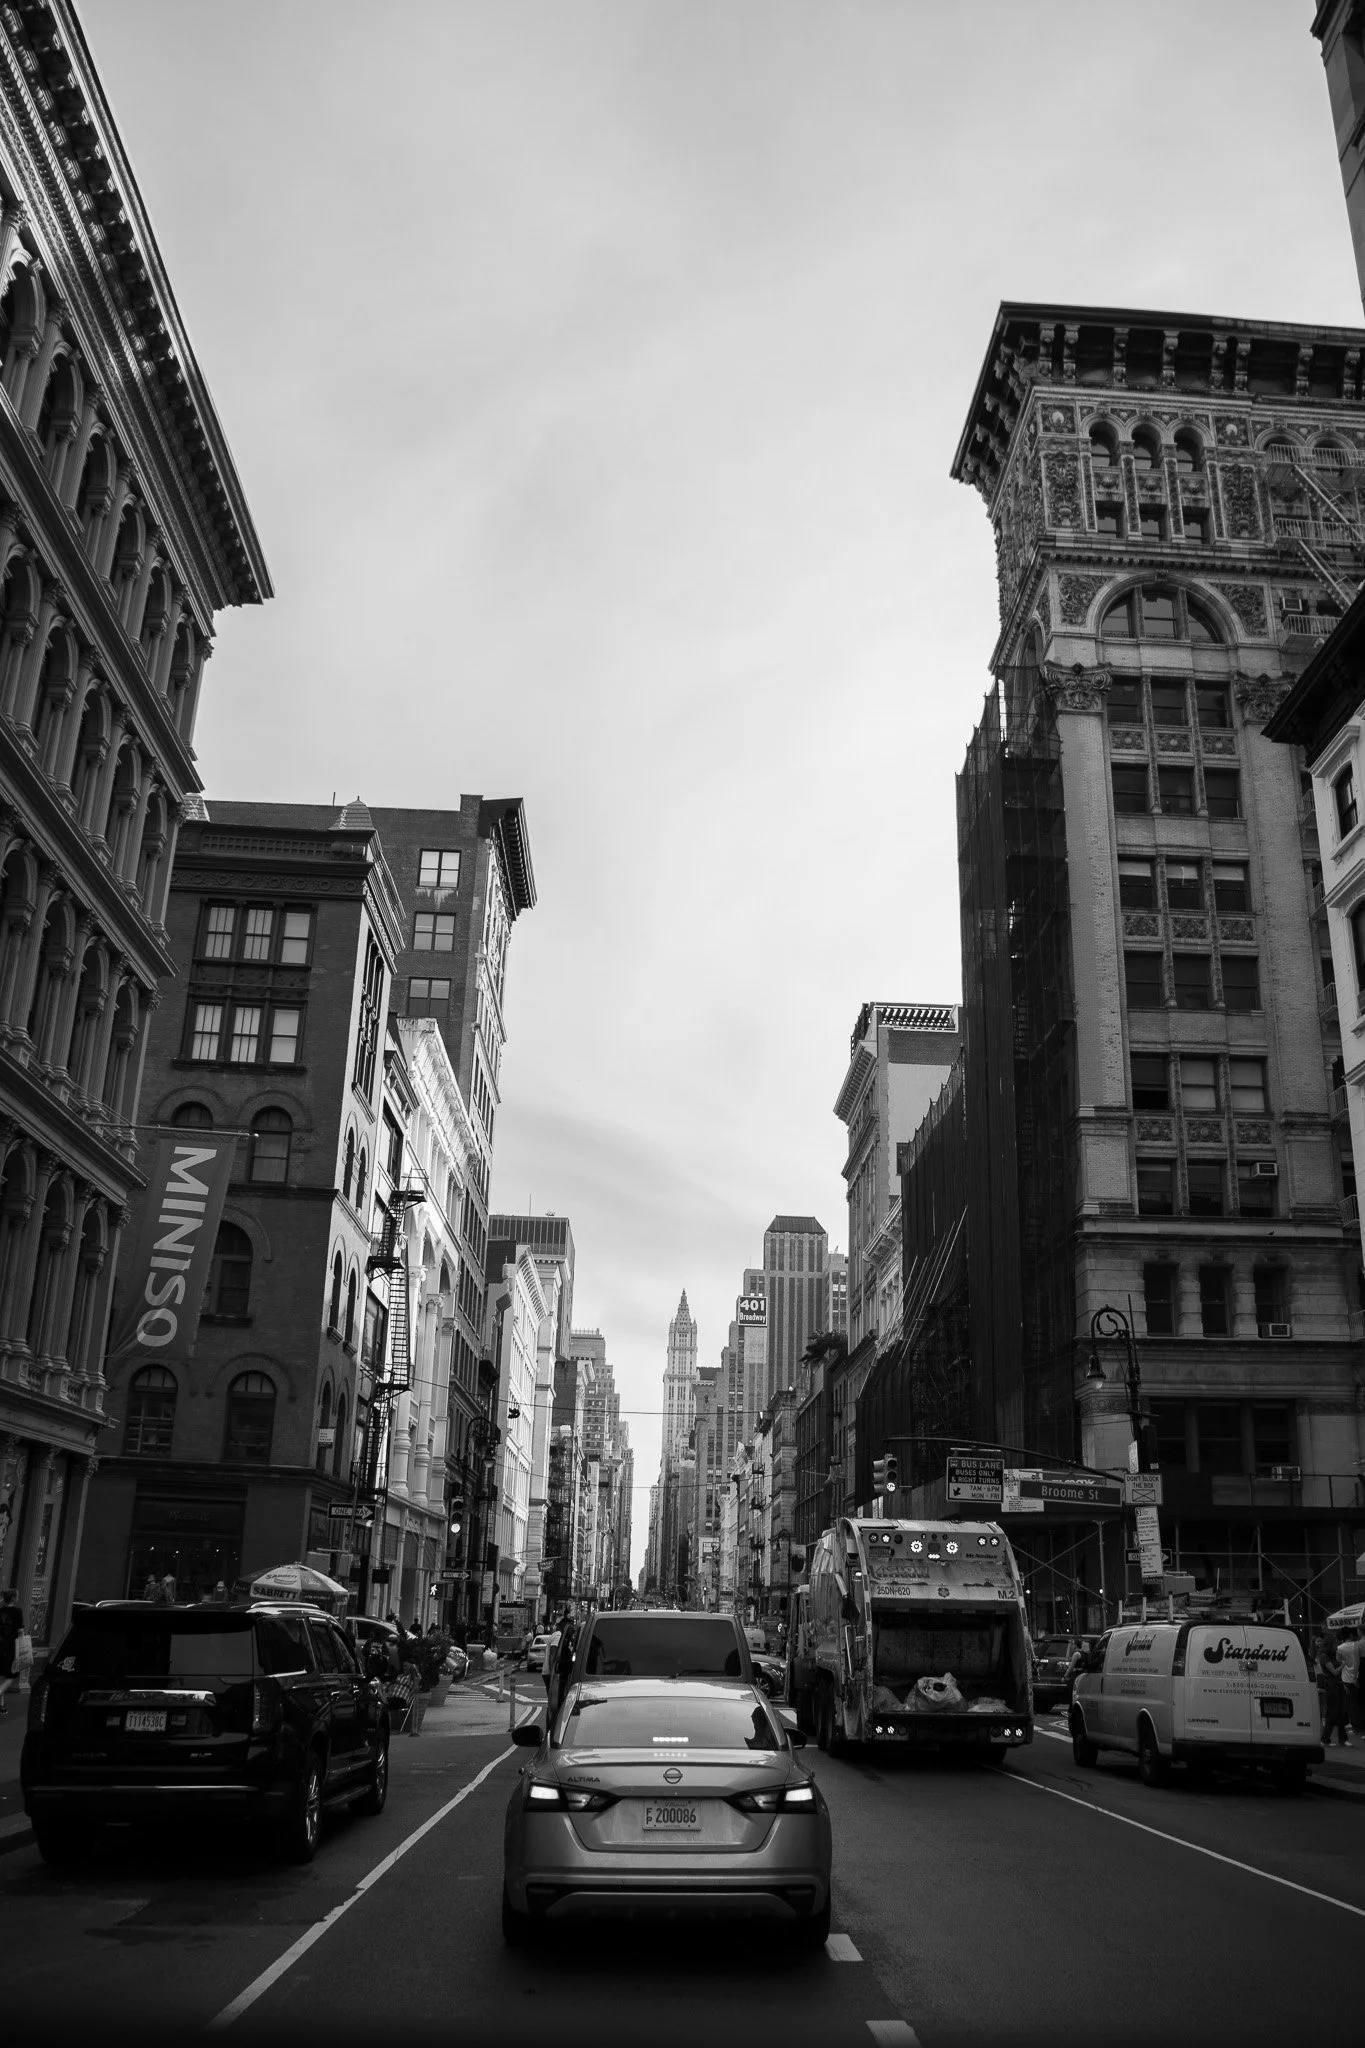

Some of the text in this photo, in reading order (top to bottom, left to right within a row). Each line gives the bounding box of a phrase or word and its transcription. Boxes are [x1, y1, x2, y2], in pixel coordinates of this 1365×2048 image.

[137, 1146, 217, 1347] MINISO
[740, 1300, 765, 1311] 401
[961, 1460, 1001, 1469] BUS LANE
[957, 1475, 976, 1483] RIGHT
[978, 1476, 1000, 1484] TURNS
[1041, 1485, 1099, 1500] Broome St
[335, 1507, 349, 1515] ONE
[253, 1586, 298, 1599] SABRETT
[877, 1586, 911, 1595] 25DN-620
[1203, 1638, 1289, 1664] Standard
[656, 1808, 696, 1823] 200086
